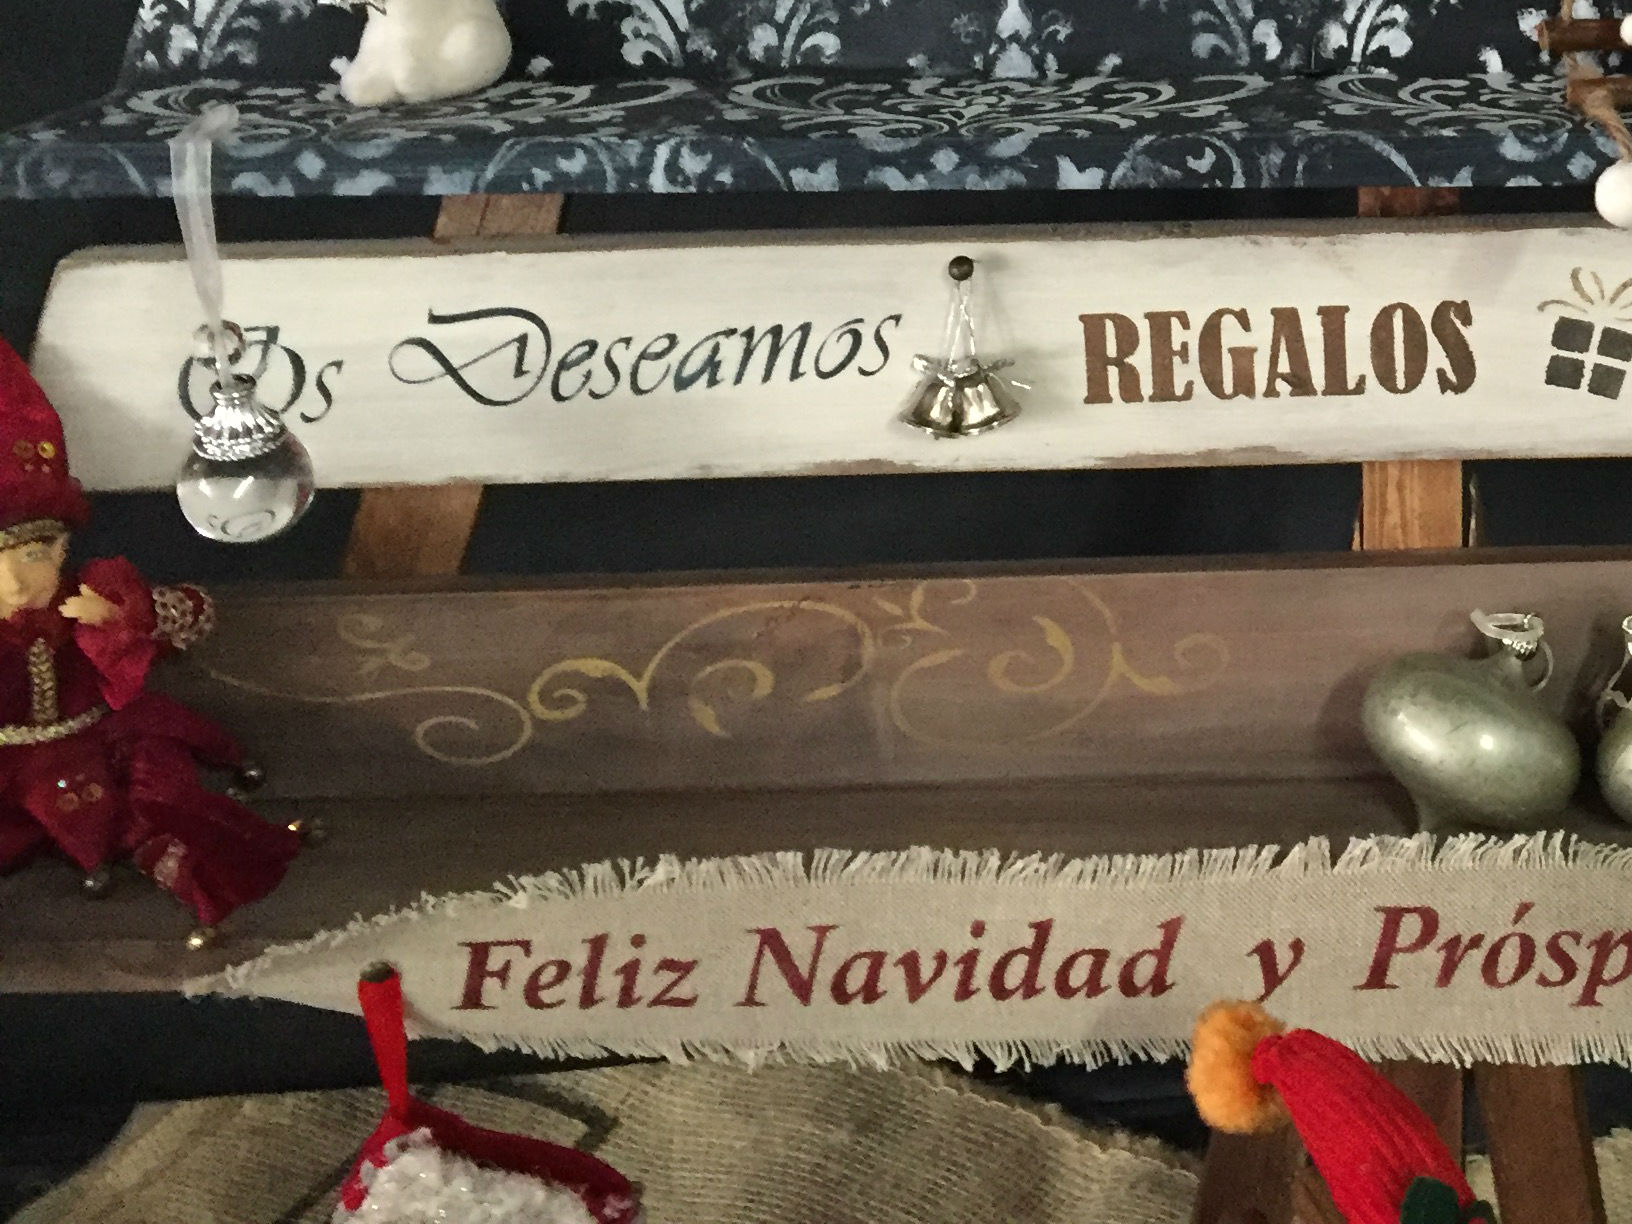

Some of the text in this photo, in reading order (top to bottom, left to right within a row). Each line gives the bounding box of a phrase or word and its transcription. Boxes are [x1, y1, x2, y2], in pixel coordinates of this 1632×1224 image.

[388, 307, 904, 407] Deseamos
[1079, 299, 1477, 404] REGALOS
[451, 933, 700, 1011] Feliz
[734, 914, 1186, 1007] Navidad
[1248, 936, 1305, 1003] y
